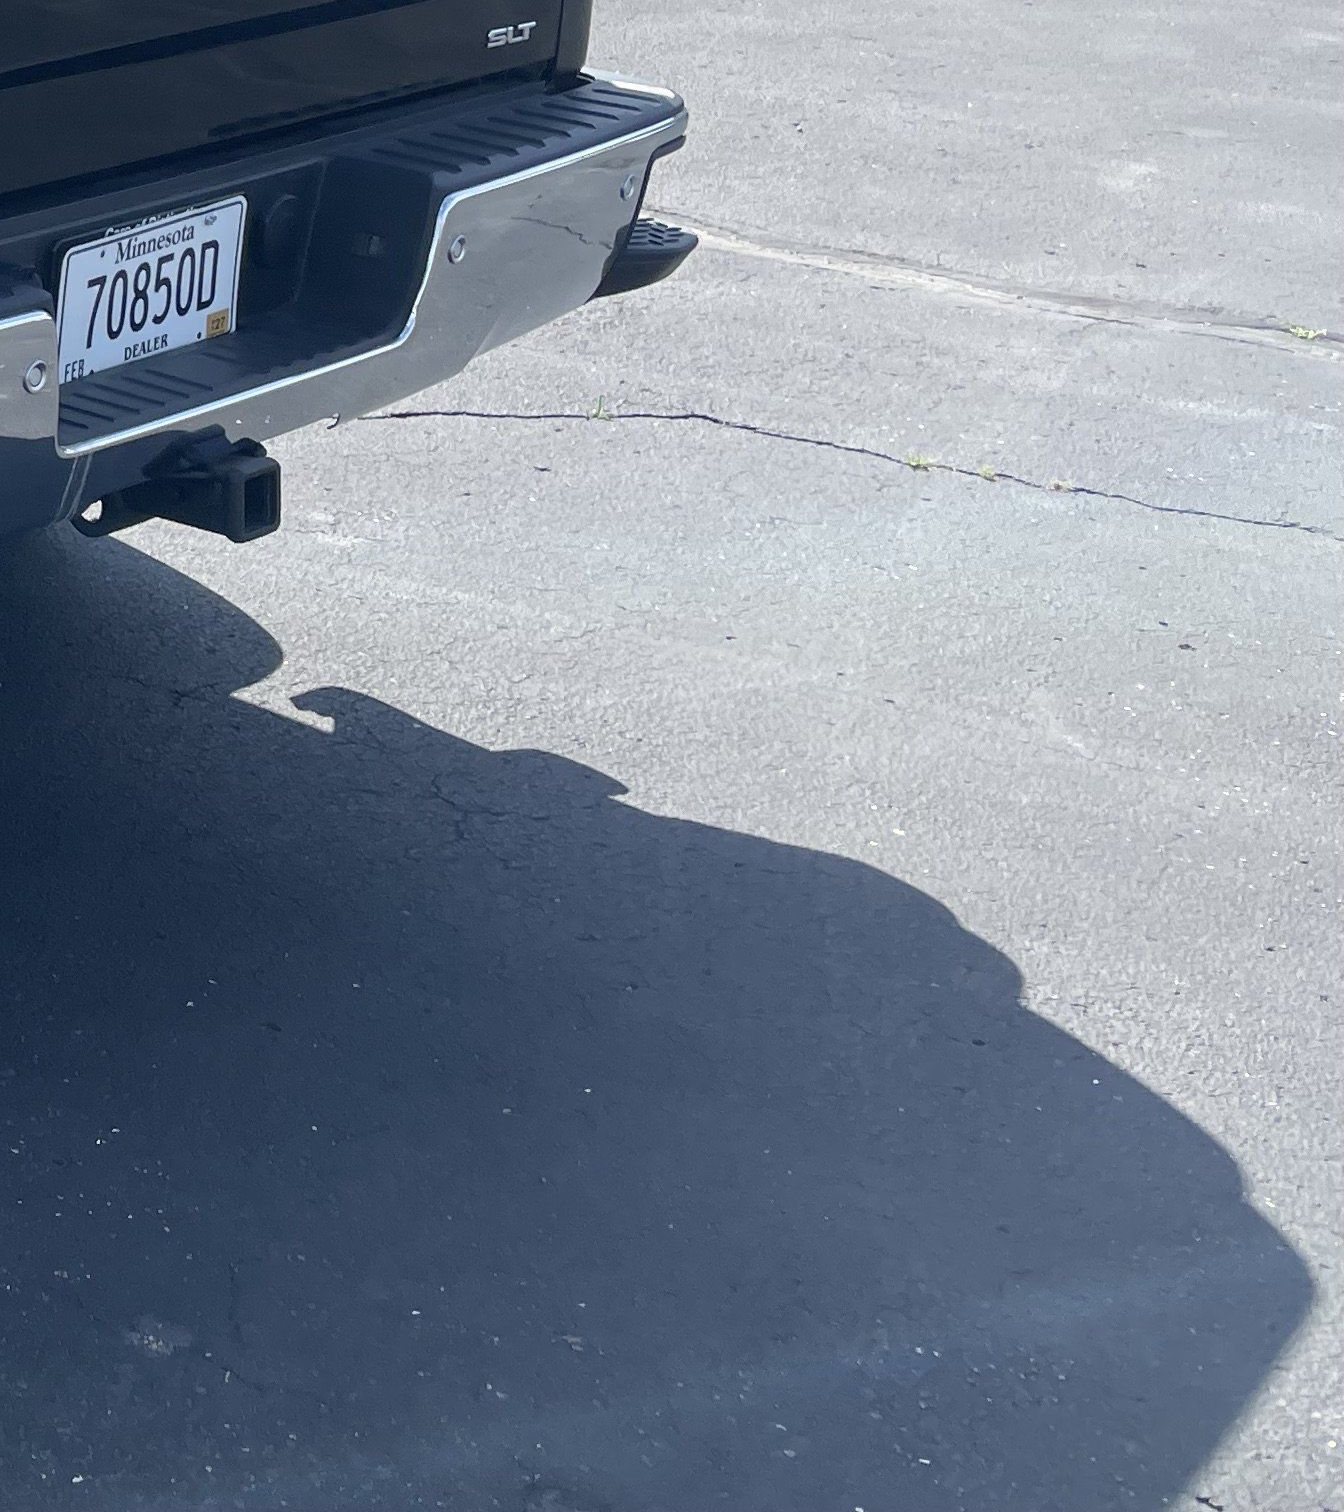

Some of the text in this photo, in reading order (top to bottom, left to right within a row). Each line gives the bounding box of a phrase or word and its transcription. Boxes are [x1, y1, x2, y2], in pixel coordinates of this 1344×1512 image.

[487, 21, 536, 48] SLT
[115, 225, 195, 264] Minnesota
[86, 239, 220, 349] 70850D
[124, 334, 169, 361] DEALER
[64, 358, 85, 383] FEB
